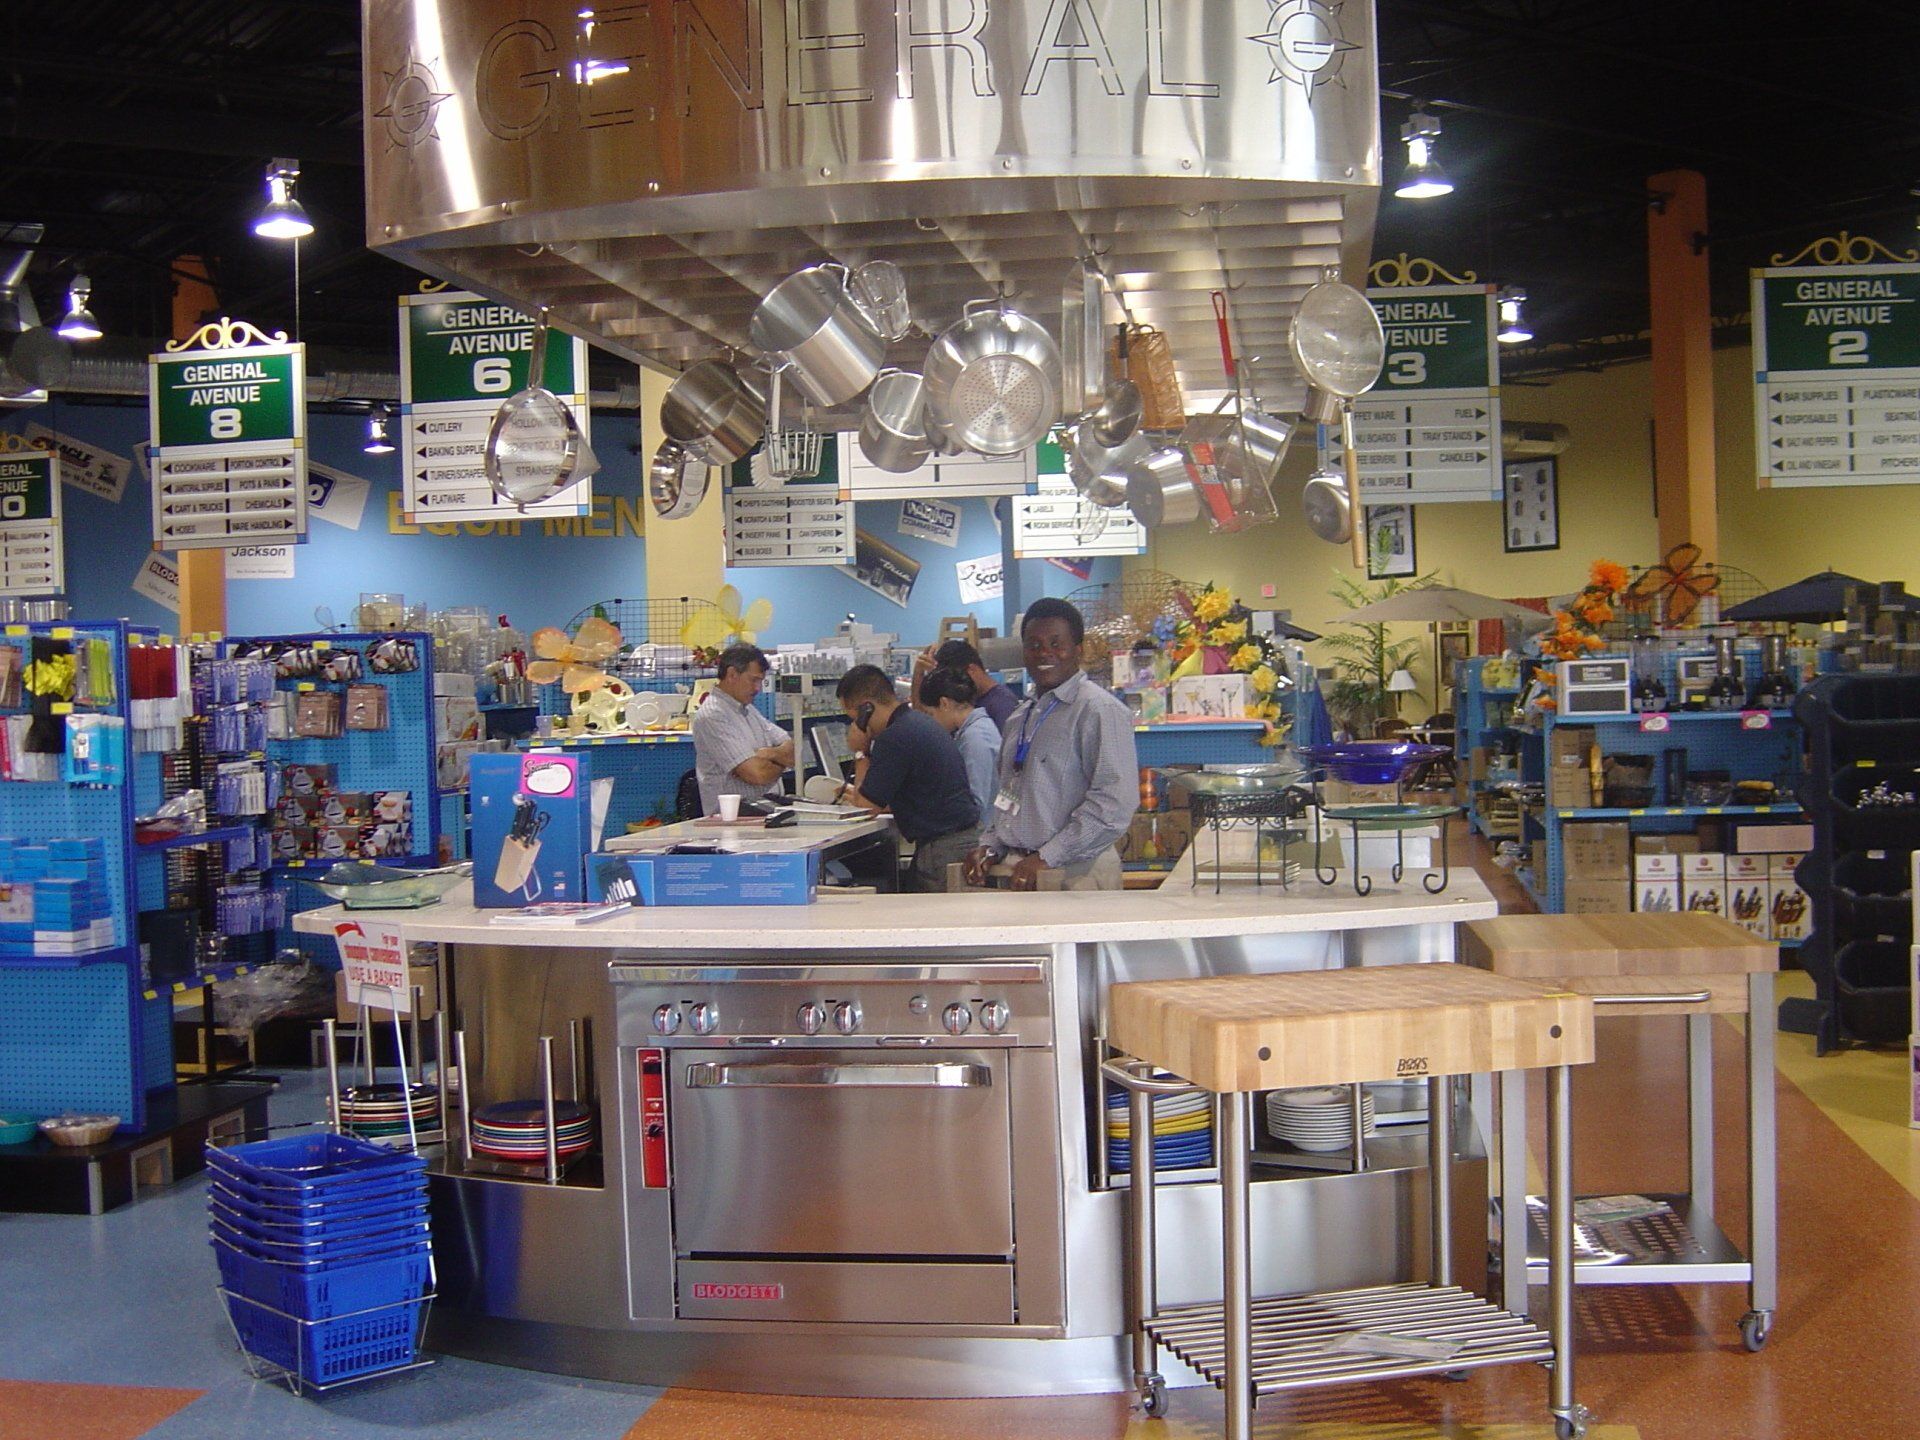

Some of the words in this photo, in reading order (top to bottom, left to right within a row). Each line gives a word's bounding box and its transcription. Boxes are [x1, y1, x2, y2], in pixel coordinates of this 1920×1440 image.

[474, 0, 1220, 141] GENERAL
[1796, 280, 1899, 300] GENERAL
[441, 306, 536, 328] GENERA
[1373, 302, 1456, 321] ENERAL
[1804, 306, 1892, 326] AVENUE
[448, 332, 534, 355] AVENUE
[1827, 330, 1870, 365] 2
[183, 361, 268, 383] GENERAL
[473, 357, 512, 393] 6
[1388, 351, 1427, 385] 3
[189, 385, 261, 406] AVENUE
[1801, 391, 1839, 401] SUPPLIES
[1454, 408, 1474, 419] FUEL
[1784, 414, 1838, 424] DISPOSABLES
[210, 407, 242, 439] 8
[428, 422, 463, 433] CUTLERY
[1422, 432, 1442, 442] TRAY
[1443, 430, 1473, 441] STANDS
[428, 446, 455, 457] BAKING
[456, 444, 484, 455] SUPPLIE
[1439, 451, 1475, 463] CANDLES
[173, 462, 216, 472] COOKWARE
[514, 465, 561, 477] STRAINERS
[244, 499, 282, 509] CHEMICALS
[431, 493, 466, 504] FLATWARE
[174, 505, 191, 514] CART
[199, 502, 224, 512] TRUCKS
[231, 545, 287, 557] Jackson
[347, 965, 365, 982] USE
[373, 968, 403, 989] BASKET
[696, 1285, 777, 1299] BLODGETT
